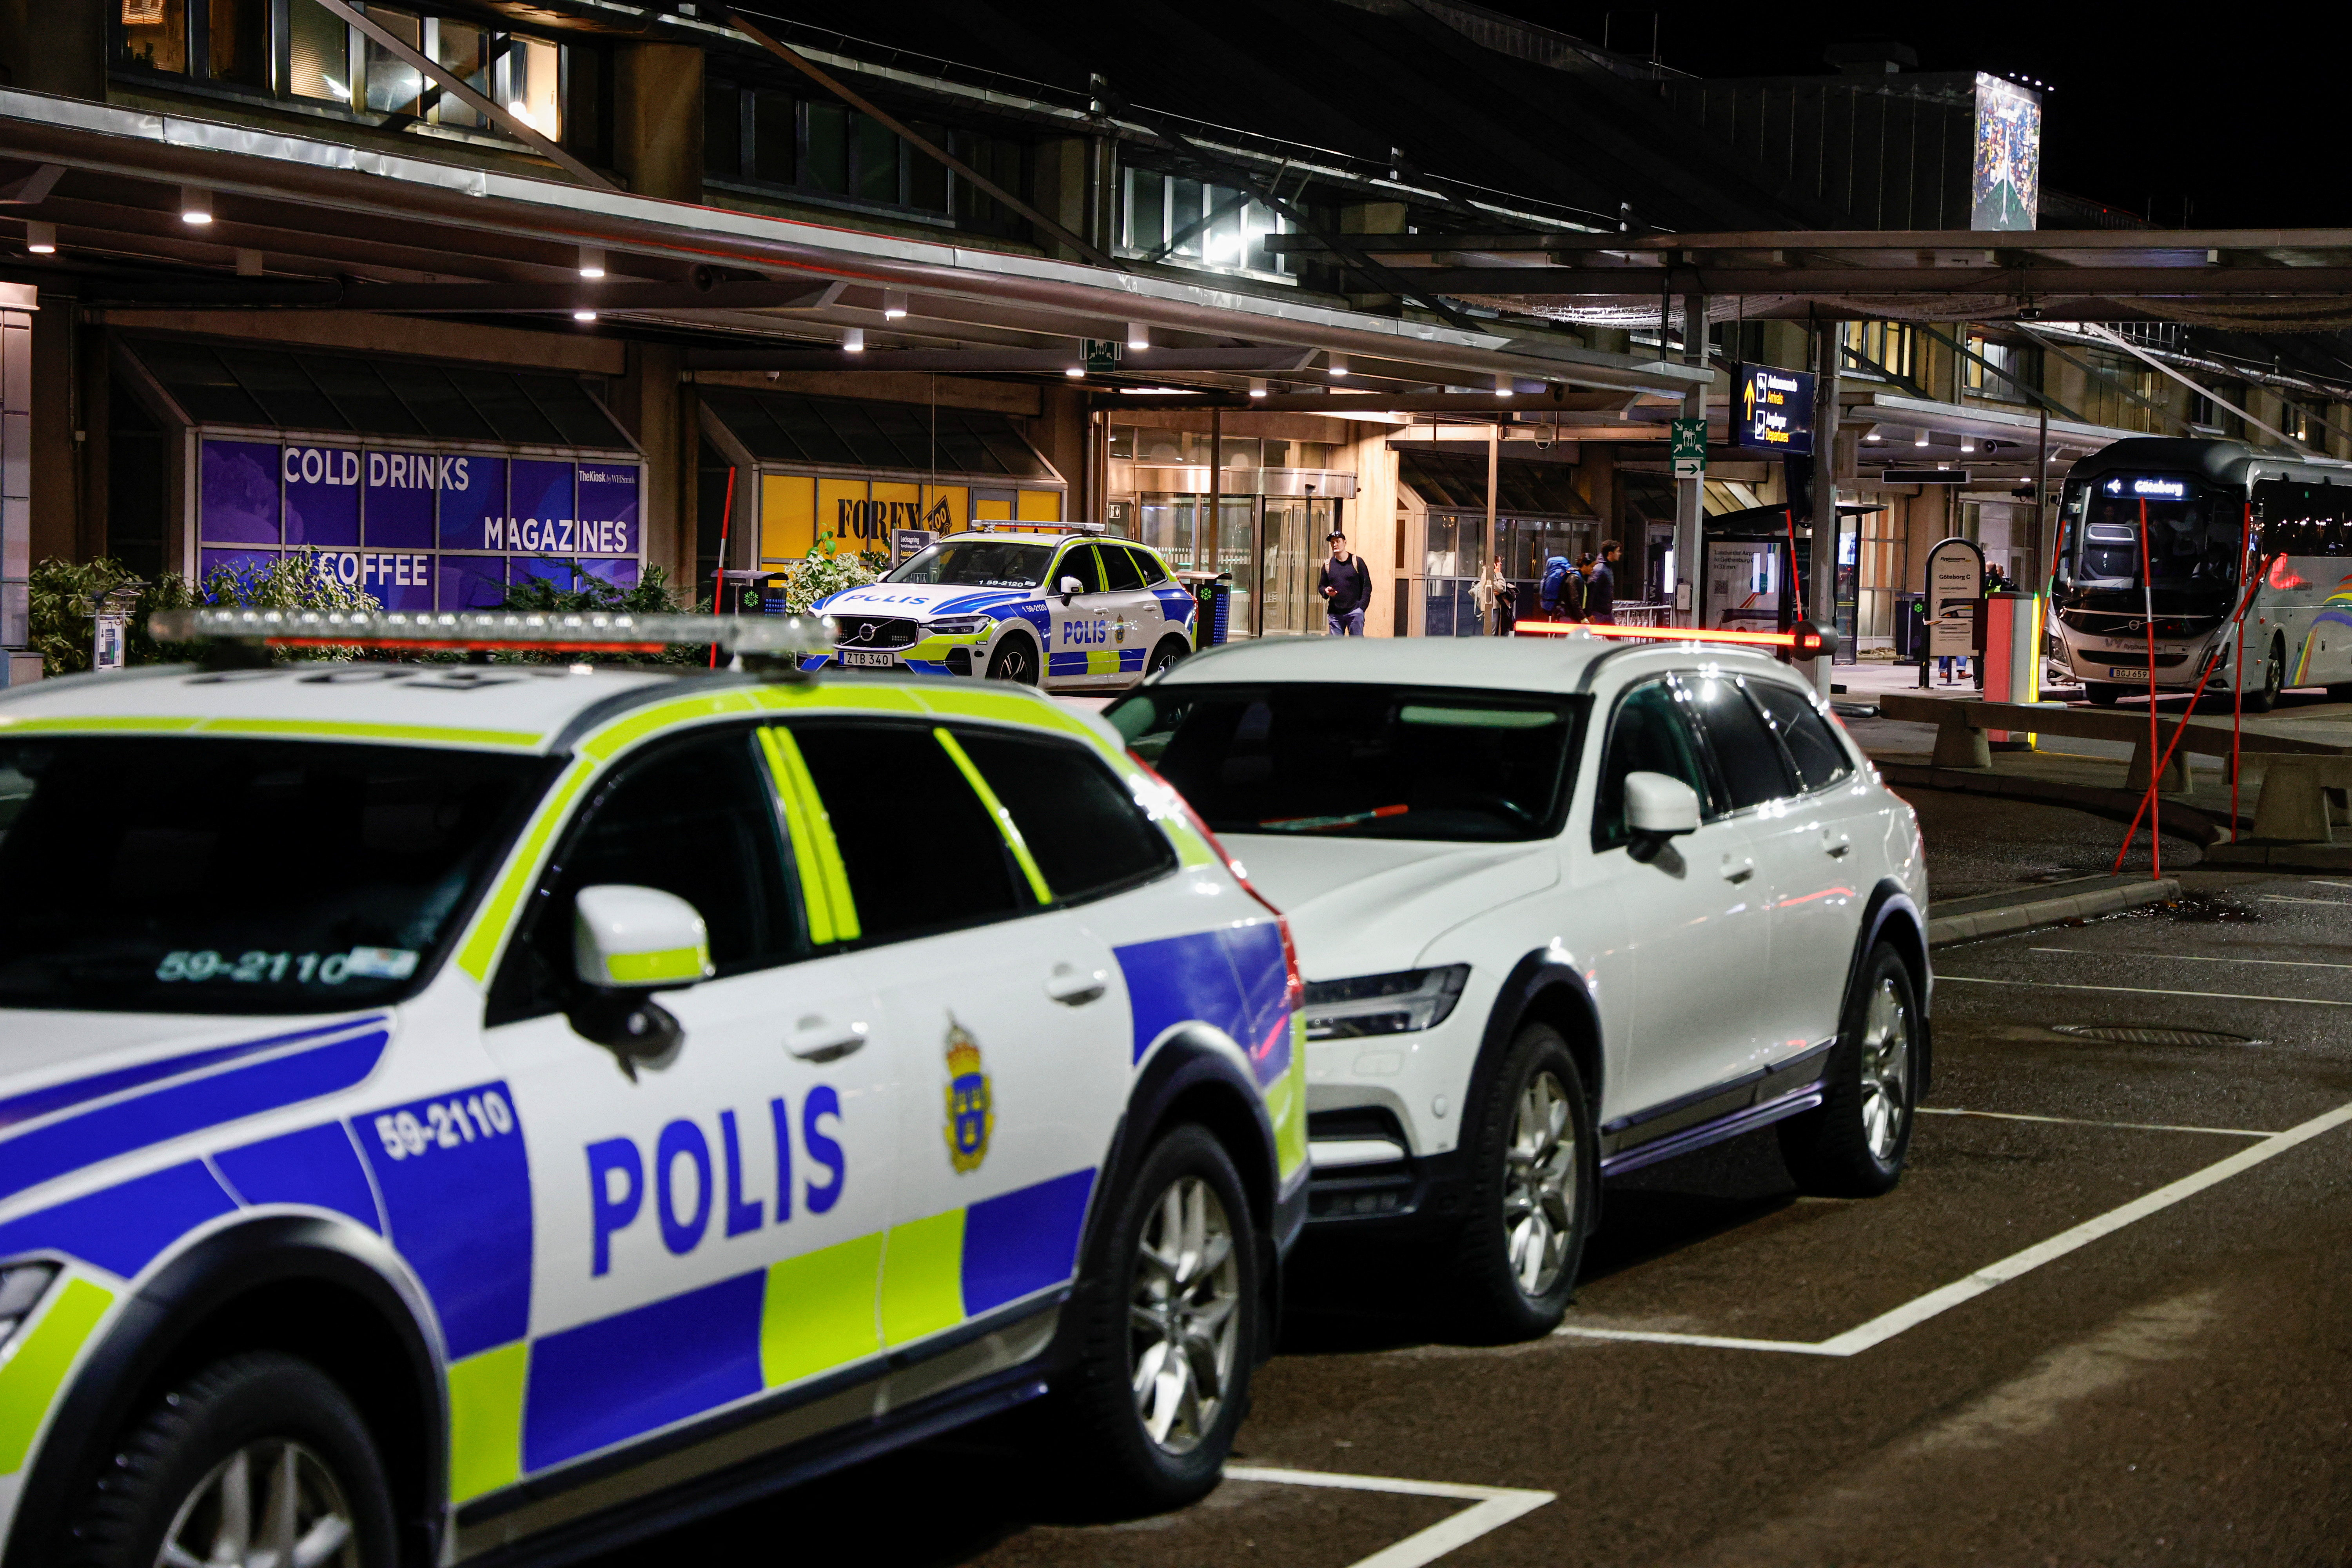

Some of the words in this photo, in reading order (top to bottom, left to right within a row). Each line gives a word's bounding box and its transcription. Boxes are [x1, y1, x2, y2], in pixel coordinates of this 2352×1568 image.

[1767, 390, 1783, 405] Arrivals
[1766, 427, 1789, 444] Departures
[285, 447, 359, 485] COLD
[370, 453, 469, 491] DRINKS
[579, 470, 606, 483] TheKiosk
[606, 474, 611, 484] by
[612, 474, 635, 484] WHSmith
[2135, 480, 2183, 496] Göteborg
[485, 517, 627, 552] MAGAZINES
[900, 535, 920, 544] Ledsagning
[843, 595, 930, 604] POLIS
[1027, 604, 1047, 613] 59-2120
[1063, 619, 1106, 644] POLIS
[847, 653, 865, 664] ZTB
[869, 654, 888, 665] 340
[156, 950, 353, 984] 59-2110
[375, 1092, 513, 1160] 59-2110
[584, 1083, 846, 1278] POLIS
